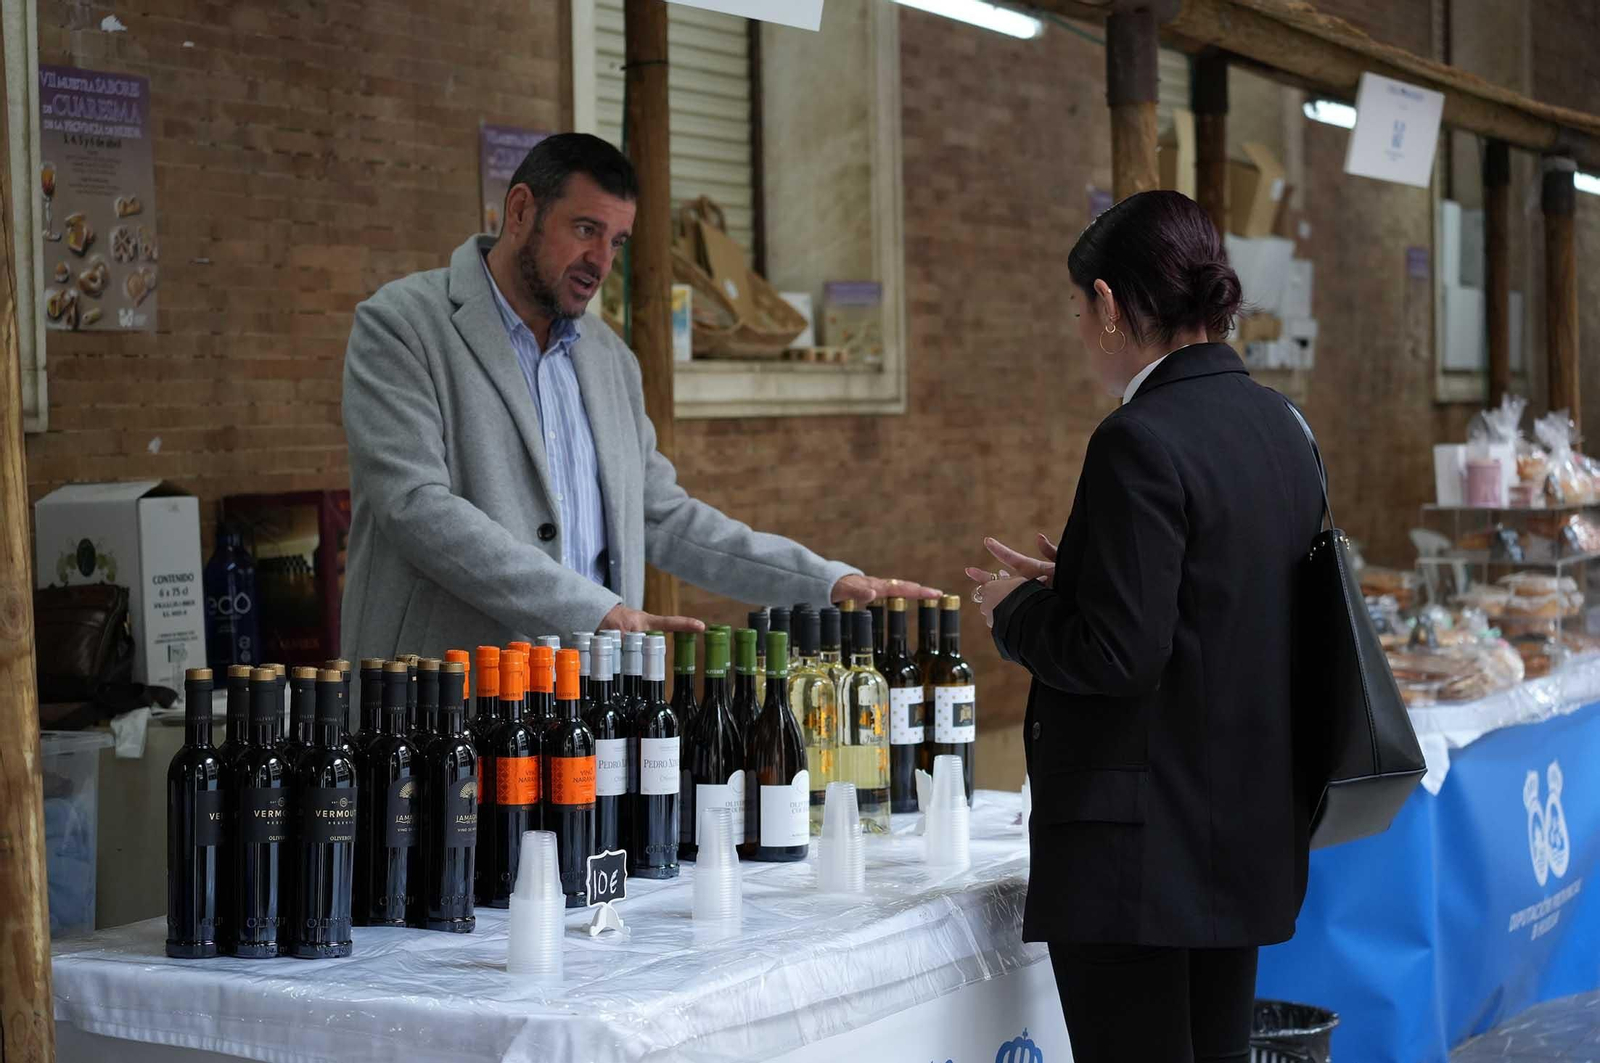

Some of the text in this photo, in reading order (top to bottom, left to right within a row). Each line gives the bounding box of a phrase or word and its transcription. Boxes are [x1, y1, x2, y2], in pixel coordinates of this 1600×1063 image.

[94, 77, 140, 97] SABORES
[52, 94, 141, 123] CUARESMA
[152, 573, 196, 586] CONTENIDO
[159, 588, 164, 597] 6
[173, 587, 182, 597] 75
[208, 592, 252, 615] eco
[598, 760, 621, 770] PEDRO
[644, 759, 668, 769] PEDRO
[593, 869, 619, 901] 10€
